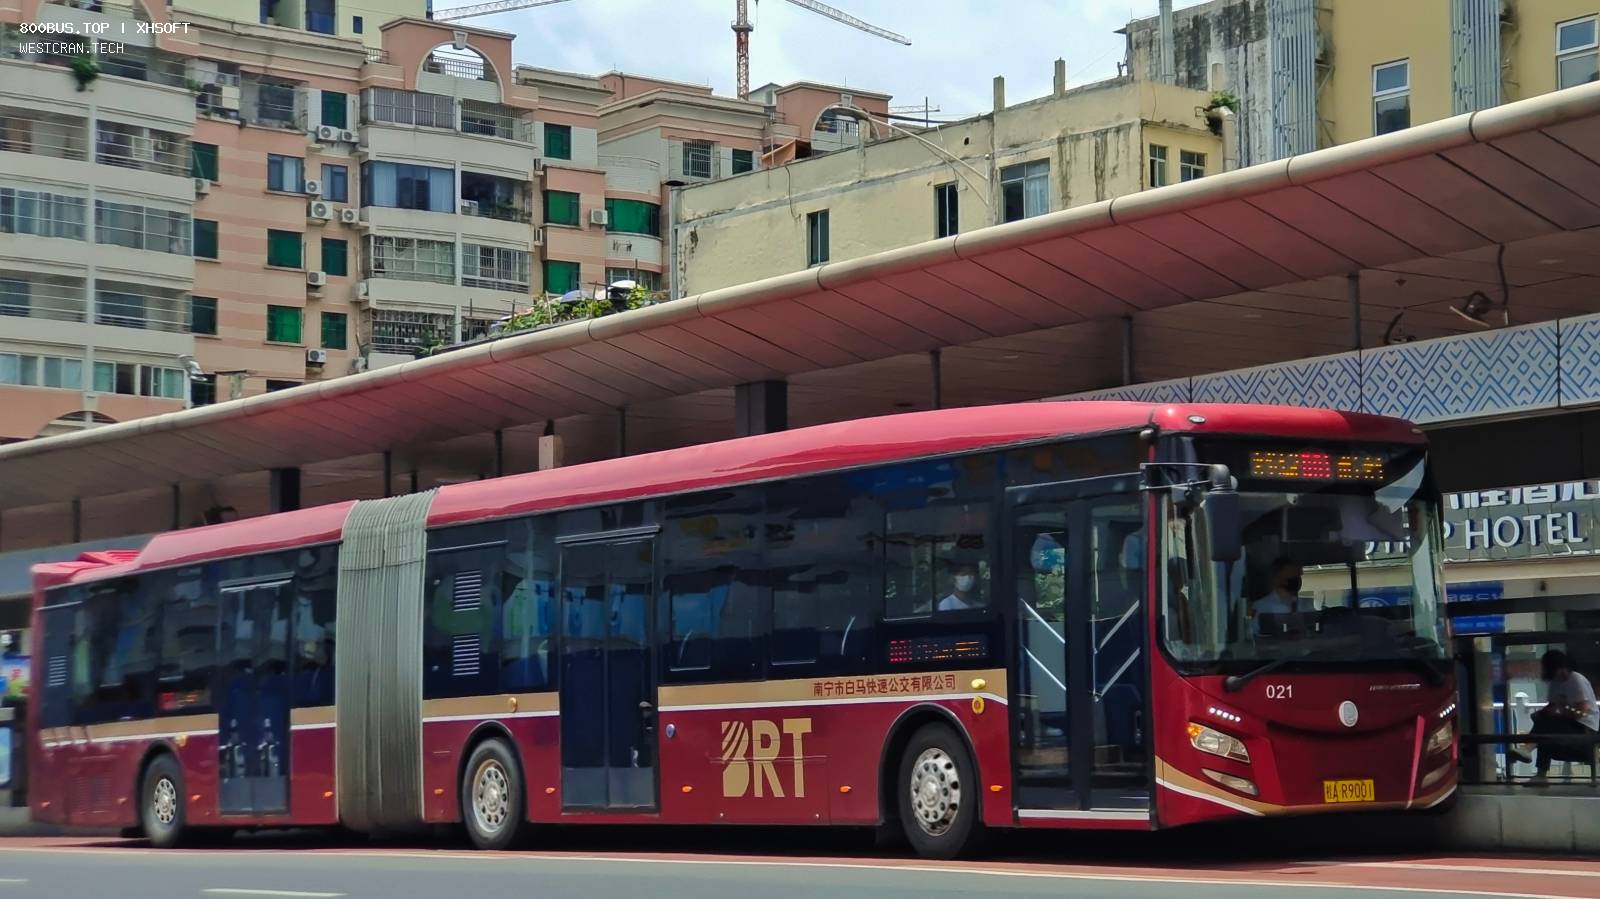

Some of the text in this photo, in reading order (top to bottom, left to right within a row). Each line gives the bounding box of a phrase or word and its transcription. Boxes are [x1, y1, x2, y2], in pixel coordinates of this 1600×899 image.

[1465, 511, 1584, 550] HOTEL
[813, 674, 956, 697] 南宁市白马快速公交有限公司
[1266, 684, 1293, 699] 021
[721, 717, 812, 798] BRT
